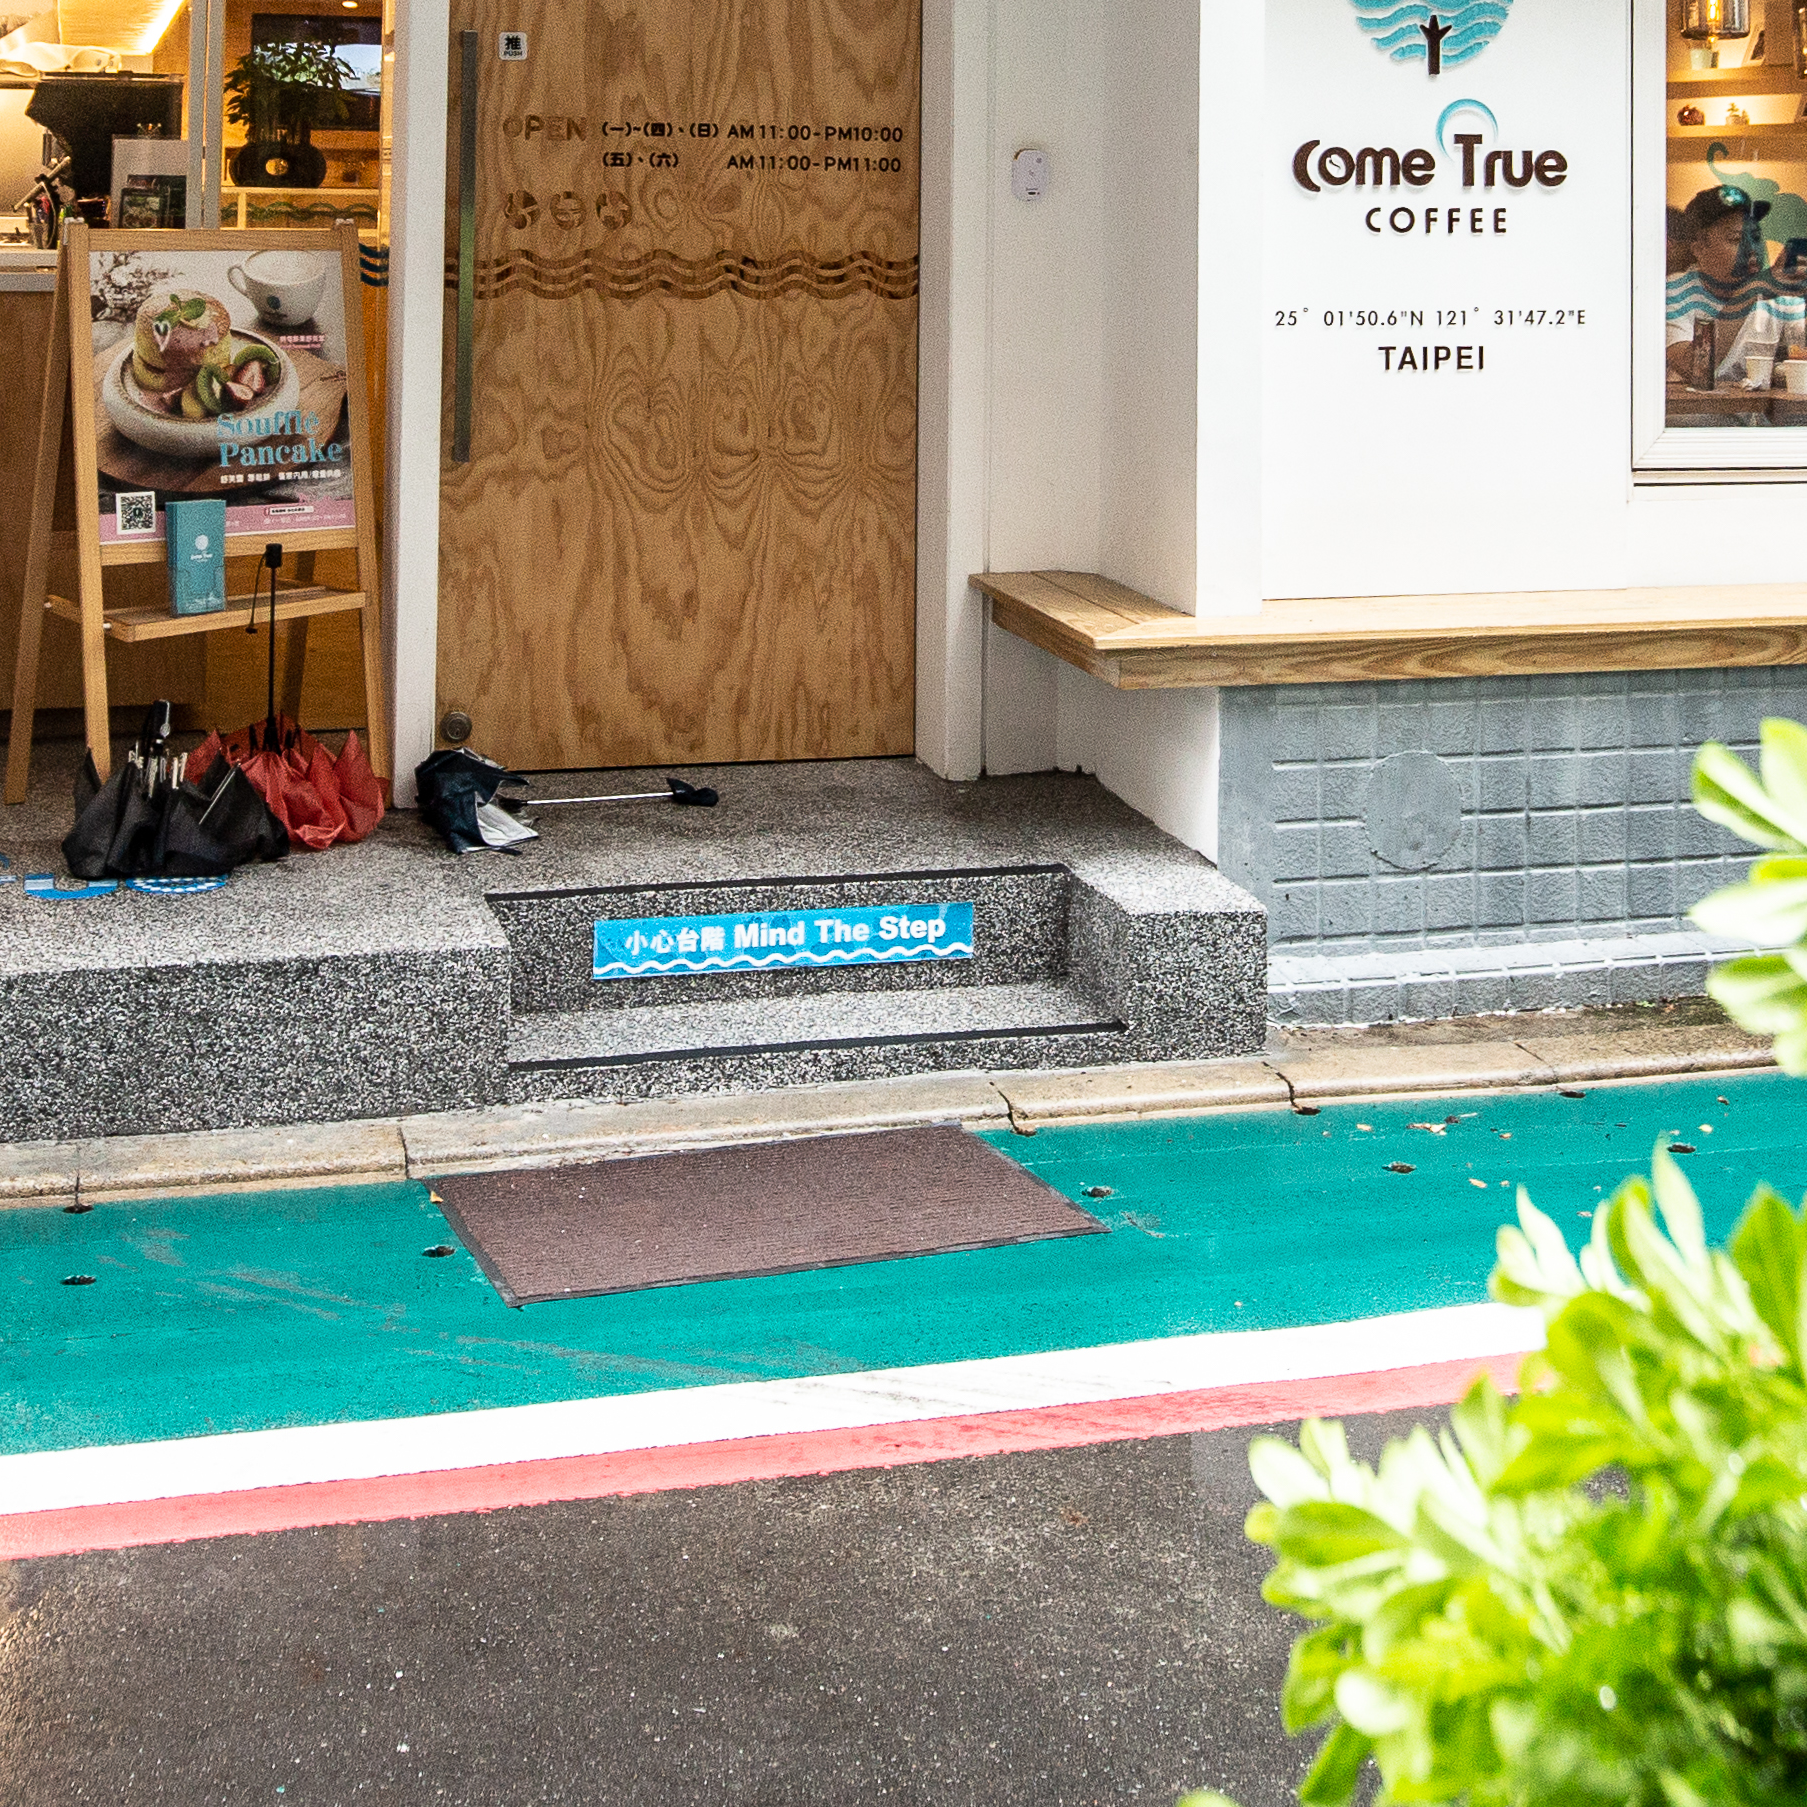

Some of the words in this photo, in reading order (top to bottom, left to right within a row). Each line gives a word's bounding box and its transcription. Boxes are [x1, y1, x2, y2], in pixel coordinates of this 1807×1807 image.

[504, 35, 522, 51] 推
[502, 114, 587, 141] OPEN
[1292, 139, 1436, 193] Come
[1453, 133, 1568, 187] True
[1365, 207, 1507, 234] COFFEE
[1377, 345, 1484, 371] TAIPEI
[219, 437, 343, 467] Pancake
[625, 925, 726, 956] 小心台階
[733, 920, 806, 949] Mind
[814, 918, 871, 944] The
[878, 914, 946, 944] Step
